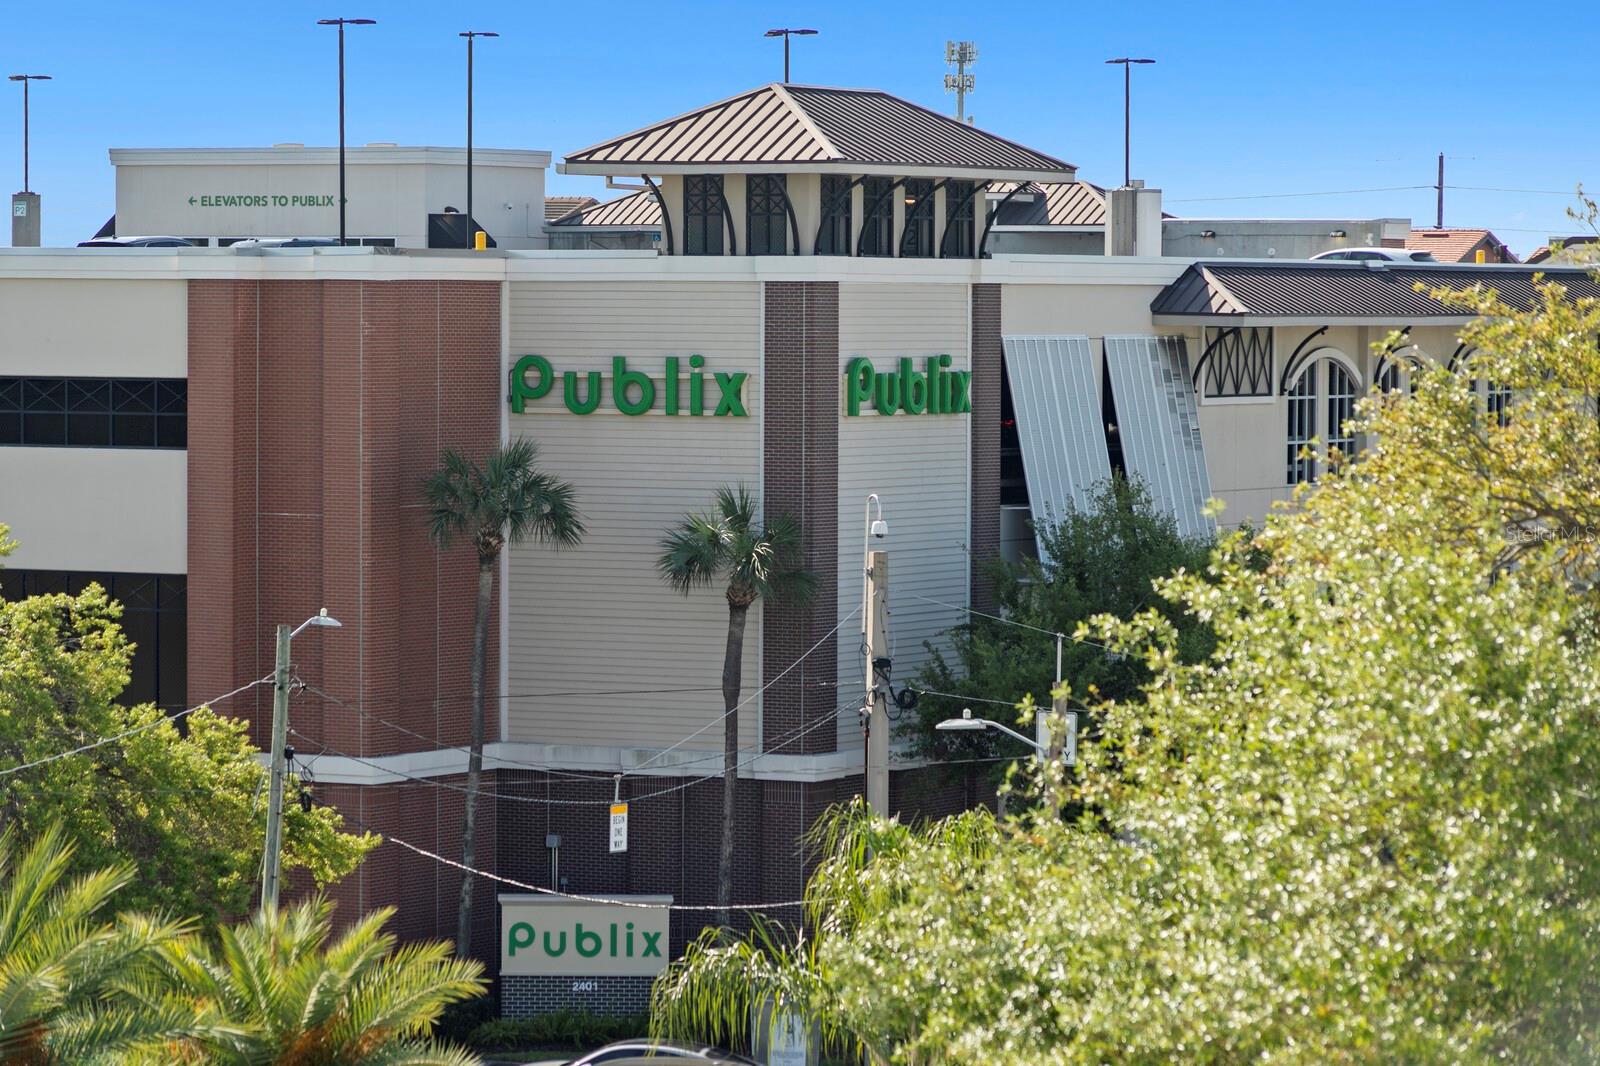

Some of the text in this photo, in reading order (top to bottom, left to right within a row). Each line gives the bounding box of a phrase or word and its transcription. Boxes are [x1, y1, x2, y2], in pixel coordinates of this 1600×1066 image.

[15, 206, 25, 215] P2
[201, 195, 334, 207] ELEVATORS TO PUBLIX
[511, 354, 749, 417] Publix
[847, 354, 972, 416] Publix
[508, 921, 662, 958] Publix
[572, 981, 598, 991] 2401
